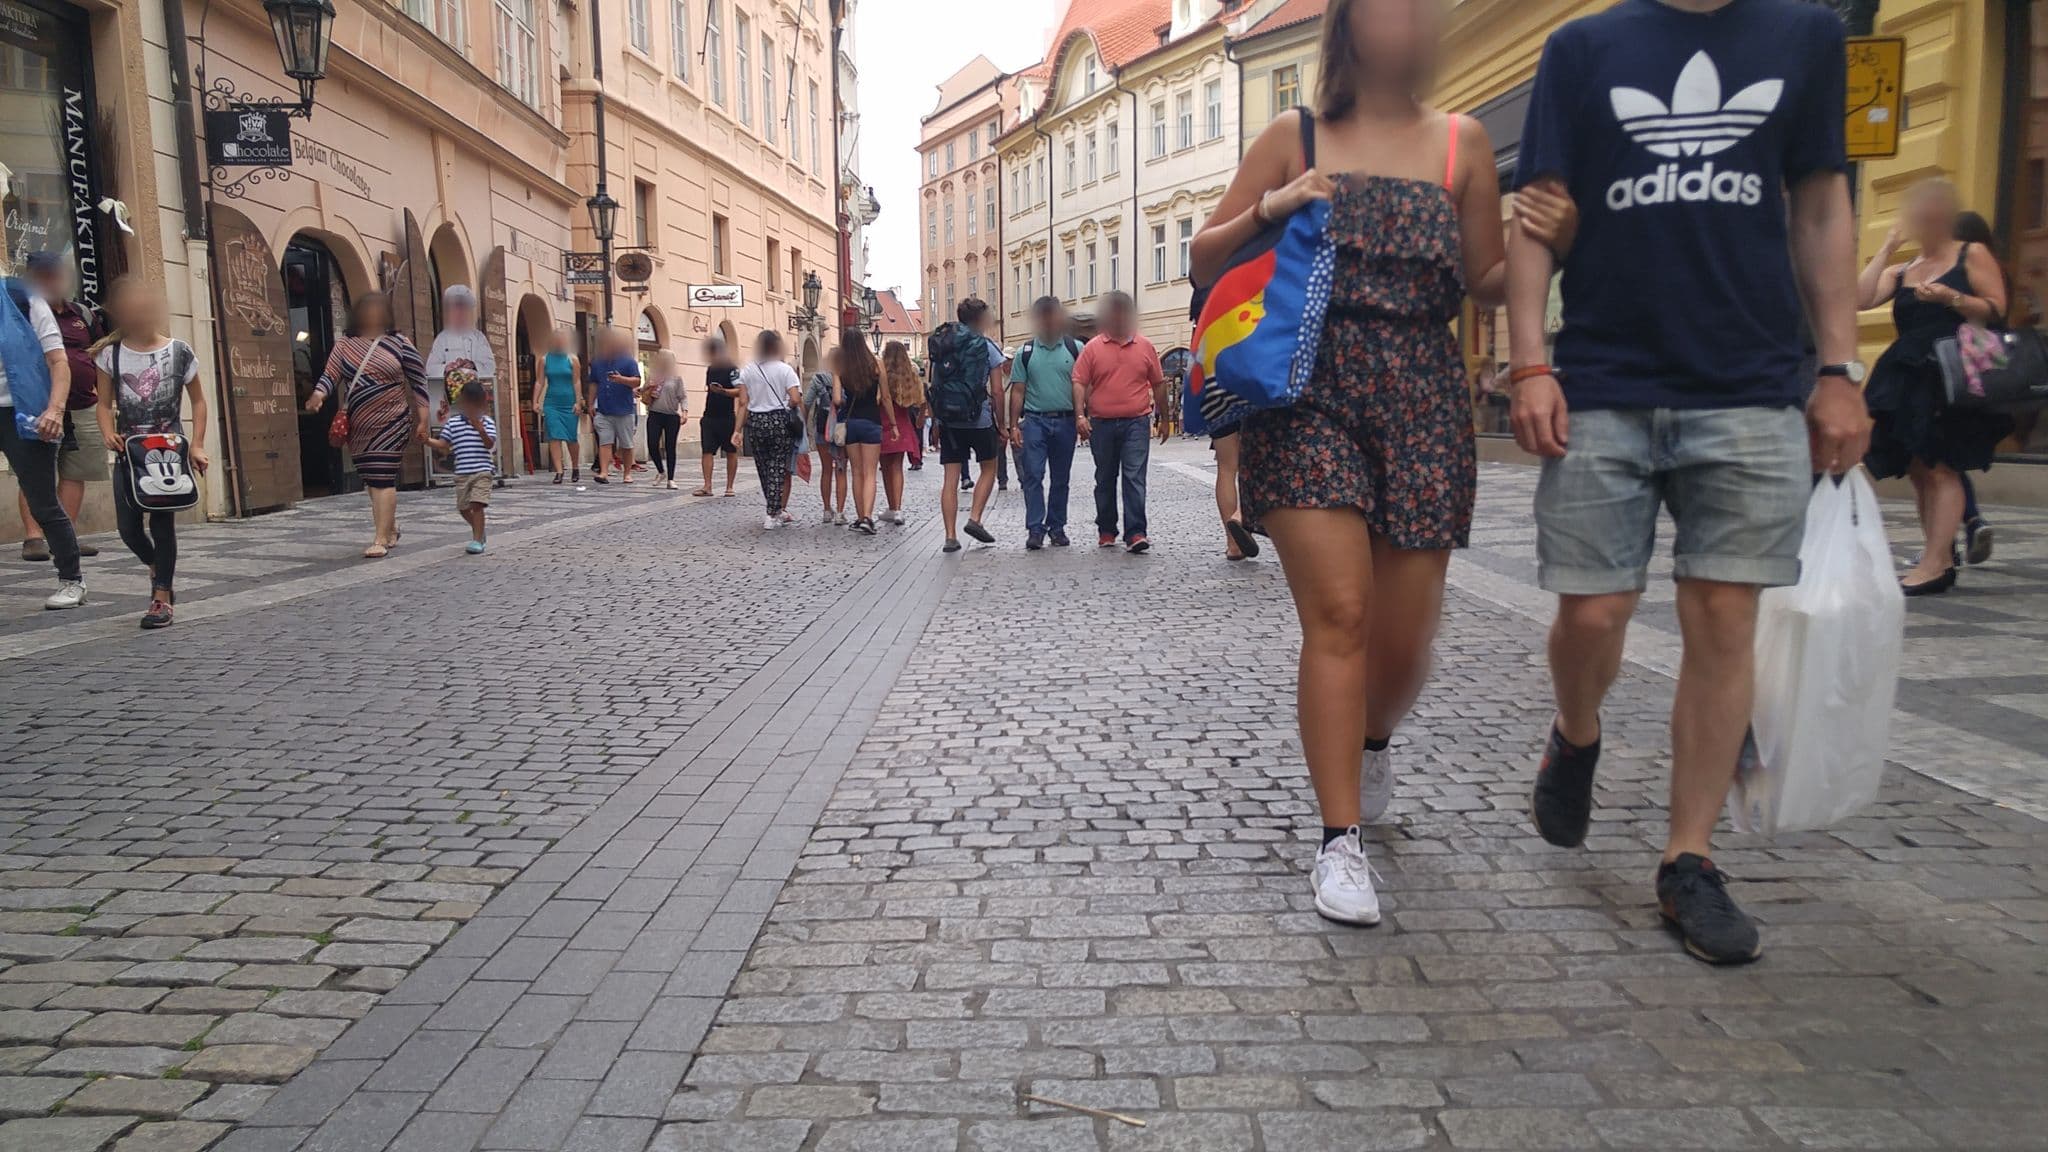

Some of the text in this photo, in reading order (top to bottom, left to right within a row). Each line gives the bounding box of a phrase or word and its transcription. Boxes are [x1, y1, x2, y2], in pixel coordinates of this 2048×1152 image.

[294, 139, 328, 166] Belgian
[63, 86, 102, 312] MANUFAKTURA
[1606, 161, 1763, 211] adidas
[5, 208, 51, 242] Original
